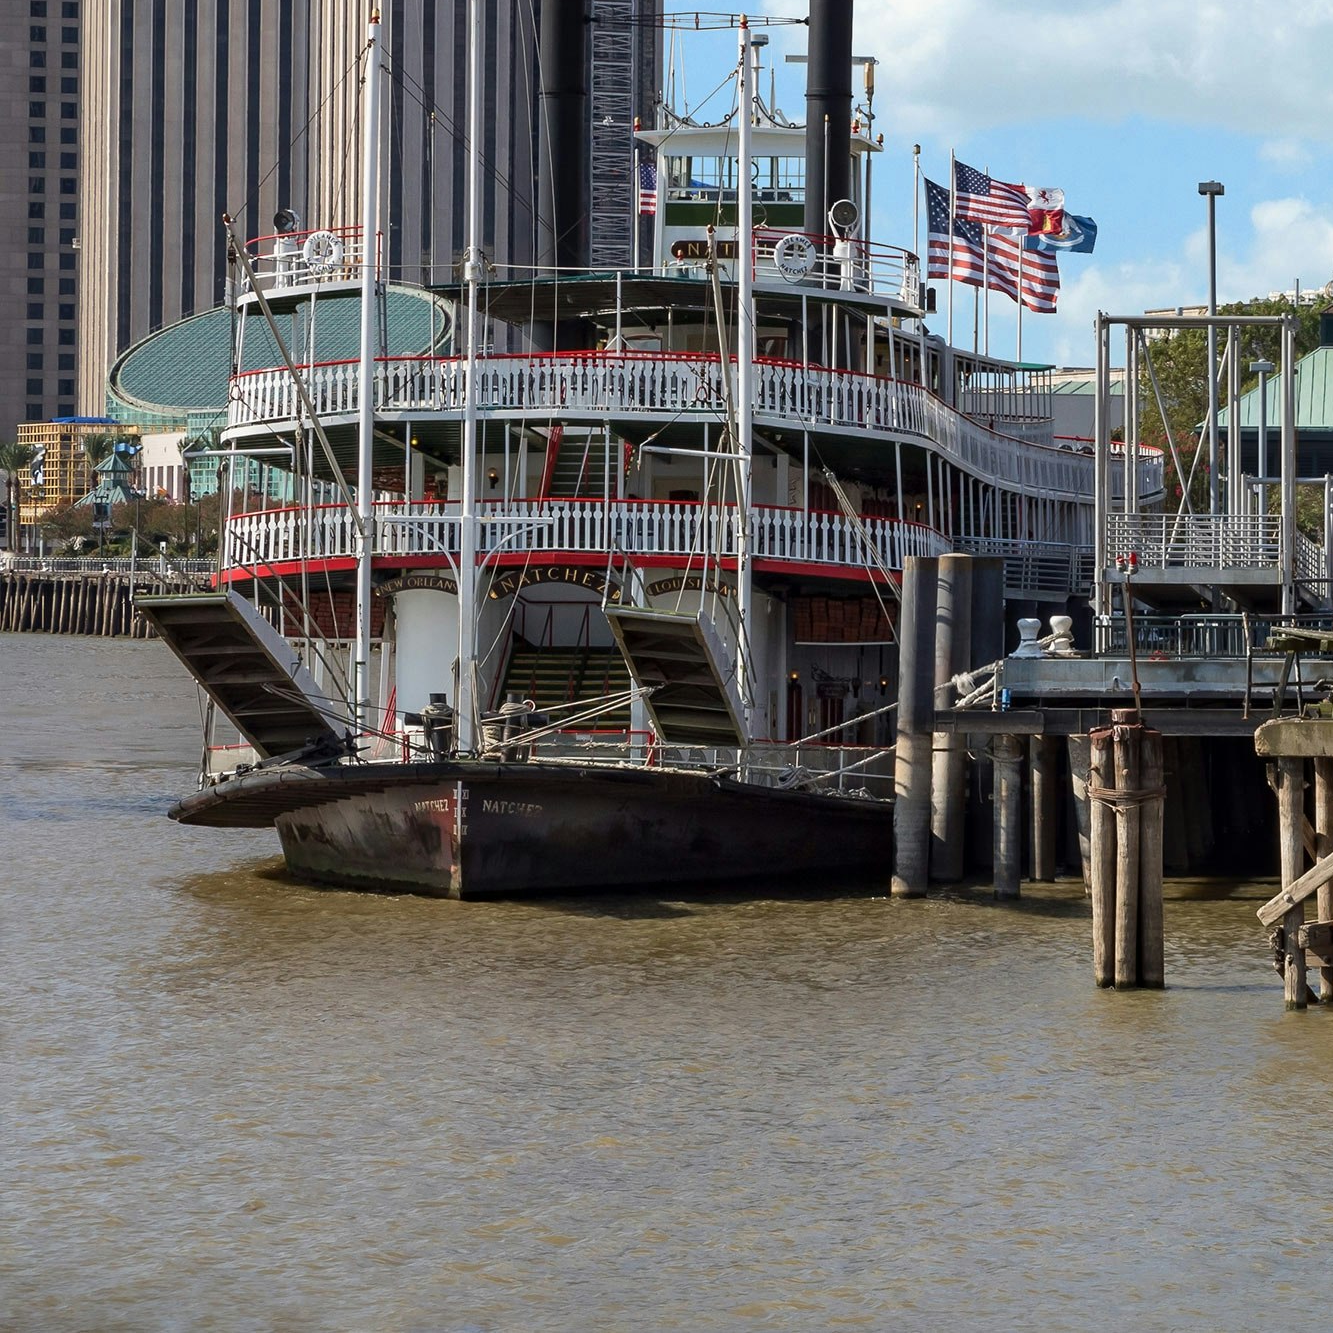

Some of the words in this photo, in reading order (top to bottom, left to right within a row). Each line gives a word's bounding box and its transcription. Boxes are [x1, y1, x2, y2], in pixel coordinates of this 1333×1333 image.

[783, 237, 812, 249] STEAMER
[780, 263, 808, 274] NATCHEZ
[380, 579, 403, 593] NEW
[408, 577, 457, 591] ORLEANS
[501, 567, 610, 593] NATCHEZ
[415, 799, 449, 811] NATCHEZ
